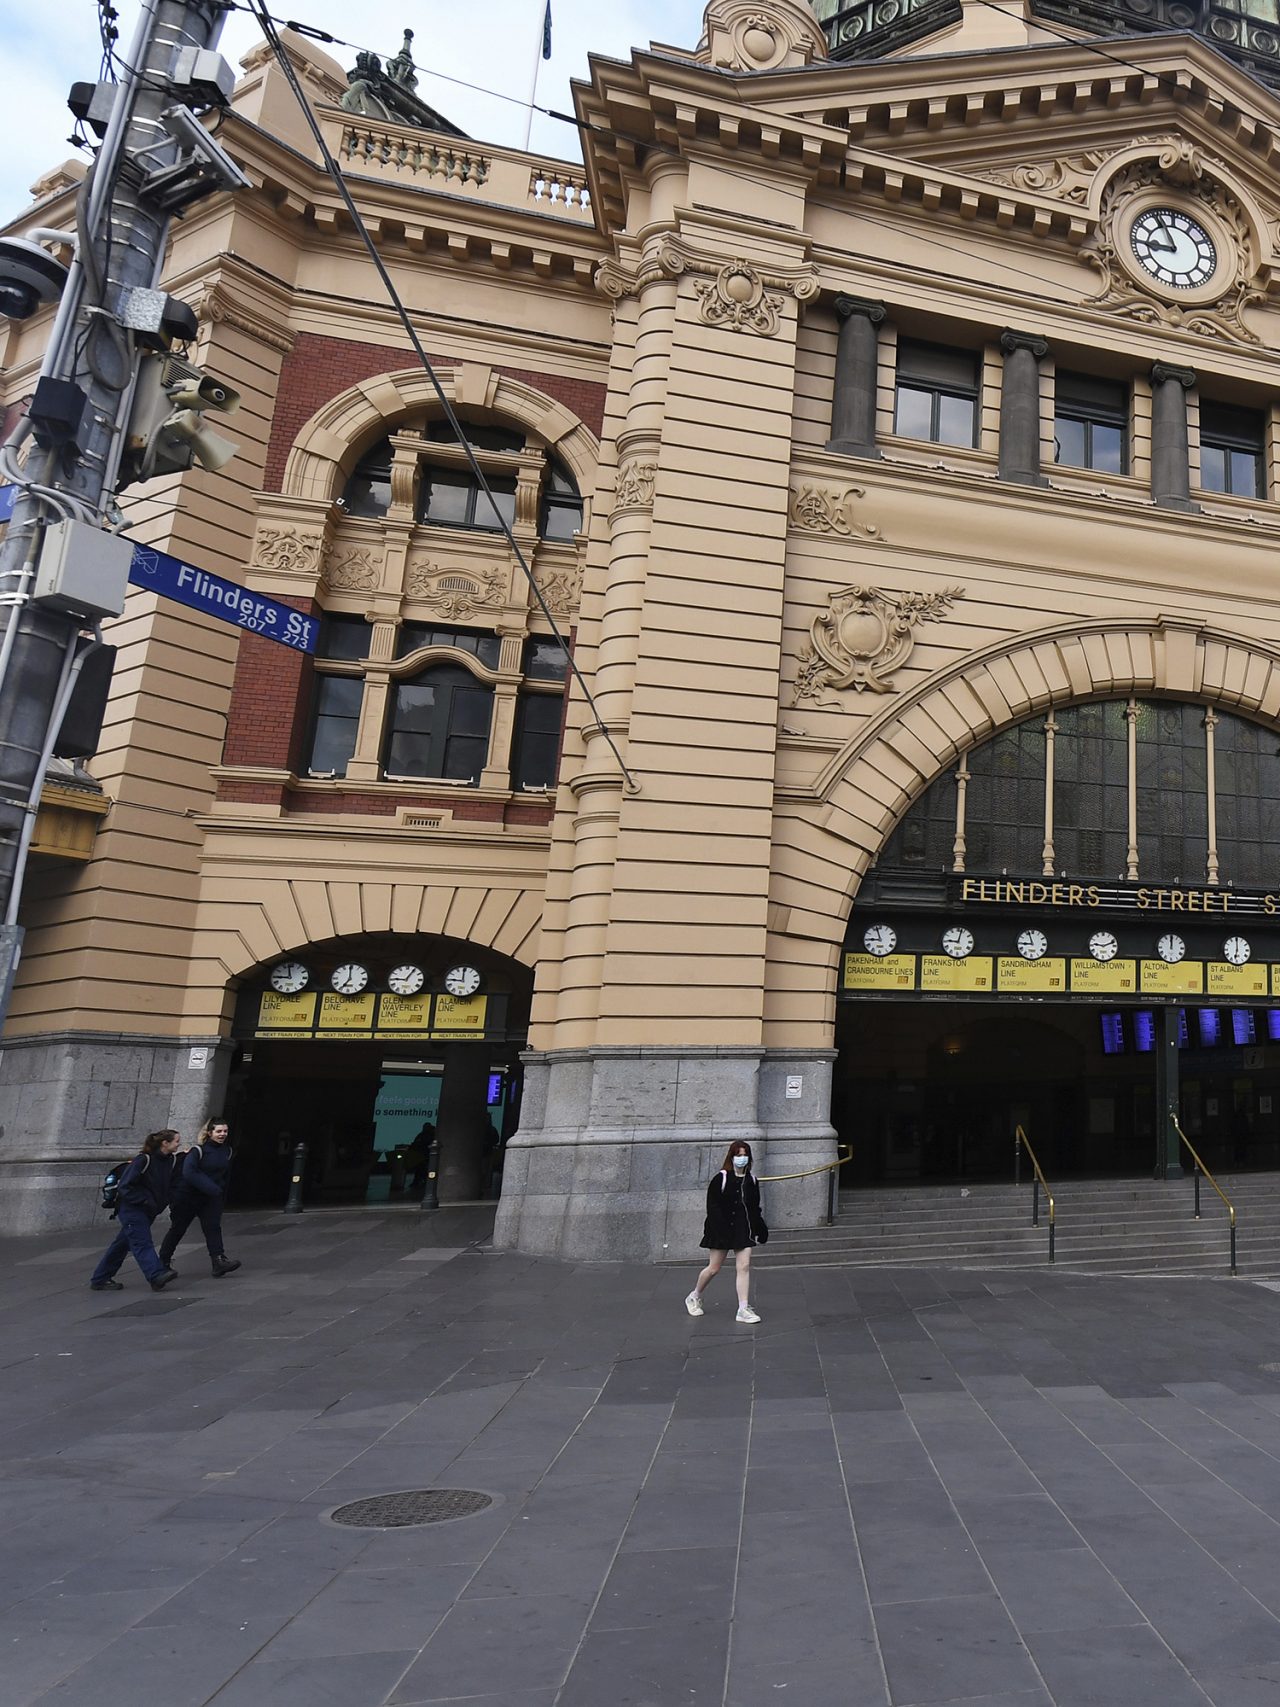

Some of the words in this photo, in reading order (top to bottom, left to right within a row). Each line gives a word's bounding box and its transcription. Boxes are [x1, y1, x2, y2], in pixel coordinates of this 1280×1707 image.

[177, 565, 277, 624] Flinders
[287, 613, 312, 639] St
[237, 613, 266, 632] 207
[282, 631, 308, 649] 273
[962, 879, 1100, 906] FLINDERS
[1137, 888, 1233, 912] STREET
[847, 957, 884, 965] PAKENHAM
[924, 959, 967, 967] FRANKSTON
[1075, 962, 1125, 970] WILLIAMSTOWN
[1144, 963, 1169, 971] ALTONA
[847, 967, 893, 975] CRANBOURNE
[895, 968, 913, 976] LINES
[264, 995, 300, 1003] LILYDALE
[324, 996, 366, 1004] BELGRAVE
[440, 998, 472, 1006] ALAMEIN
[383, 1108, 433, 1118] something
